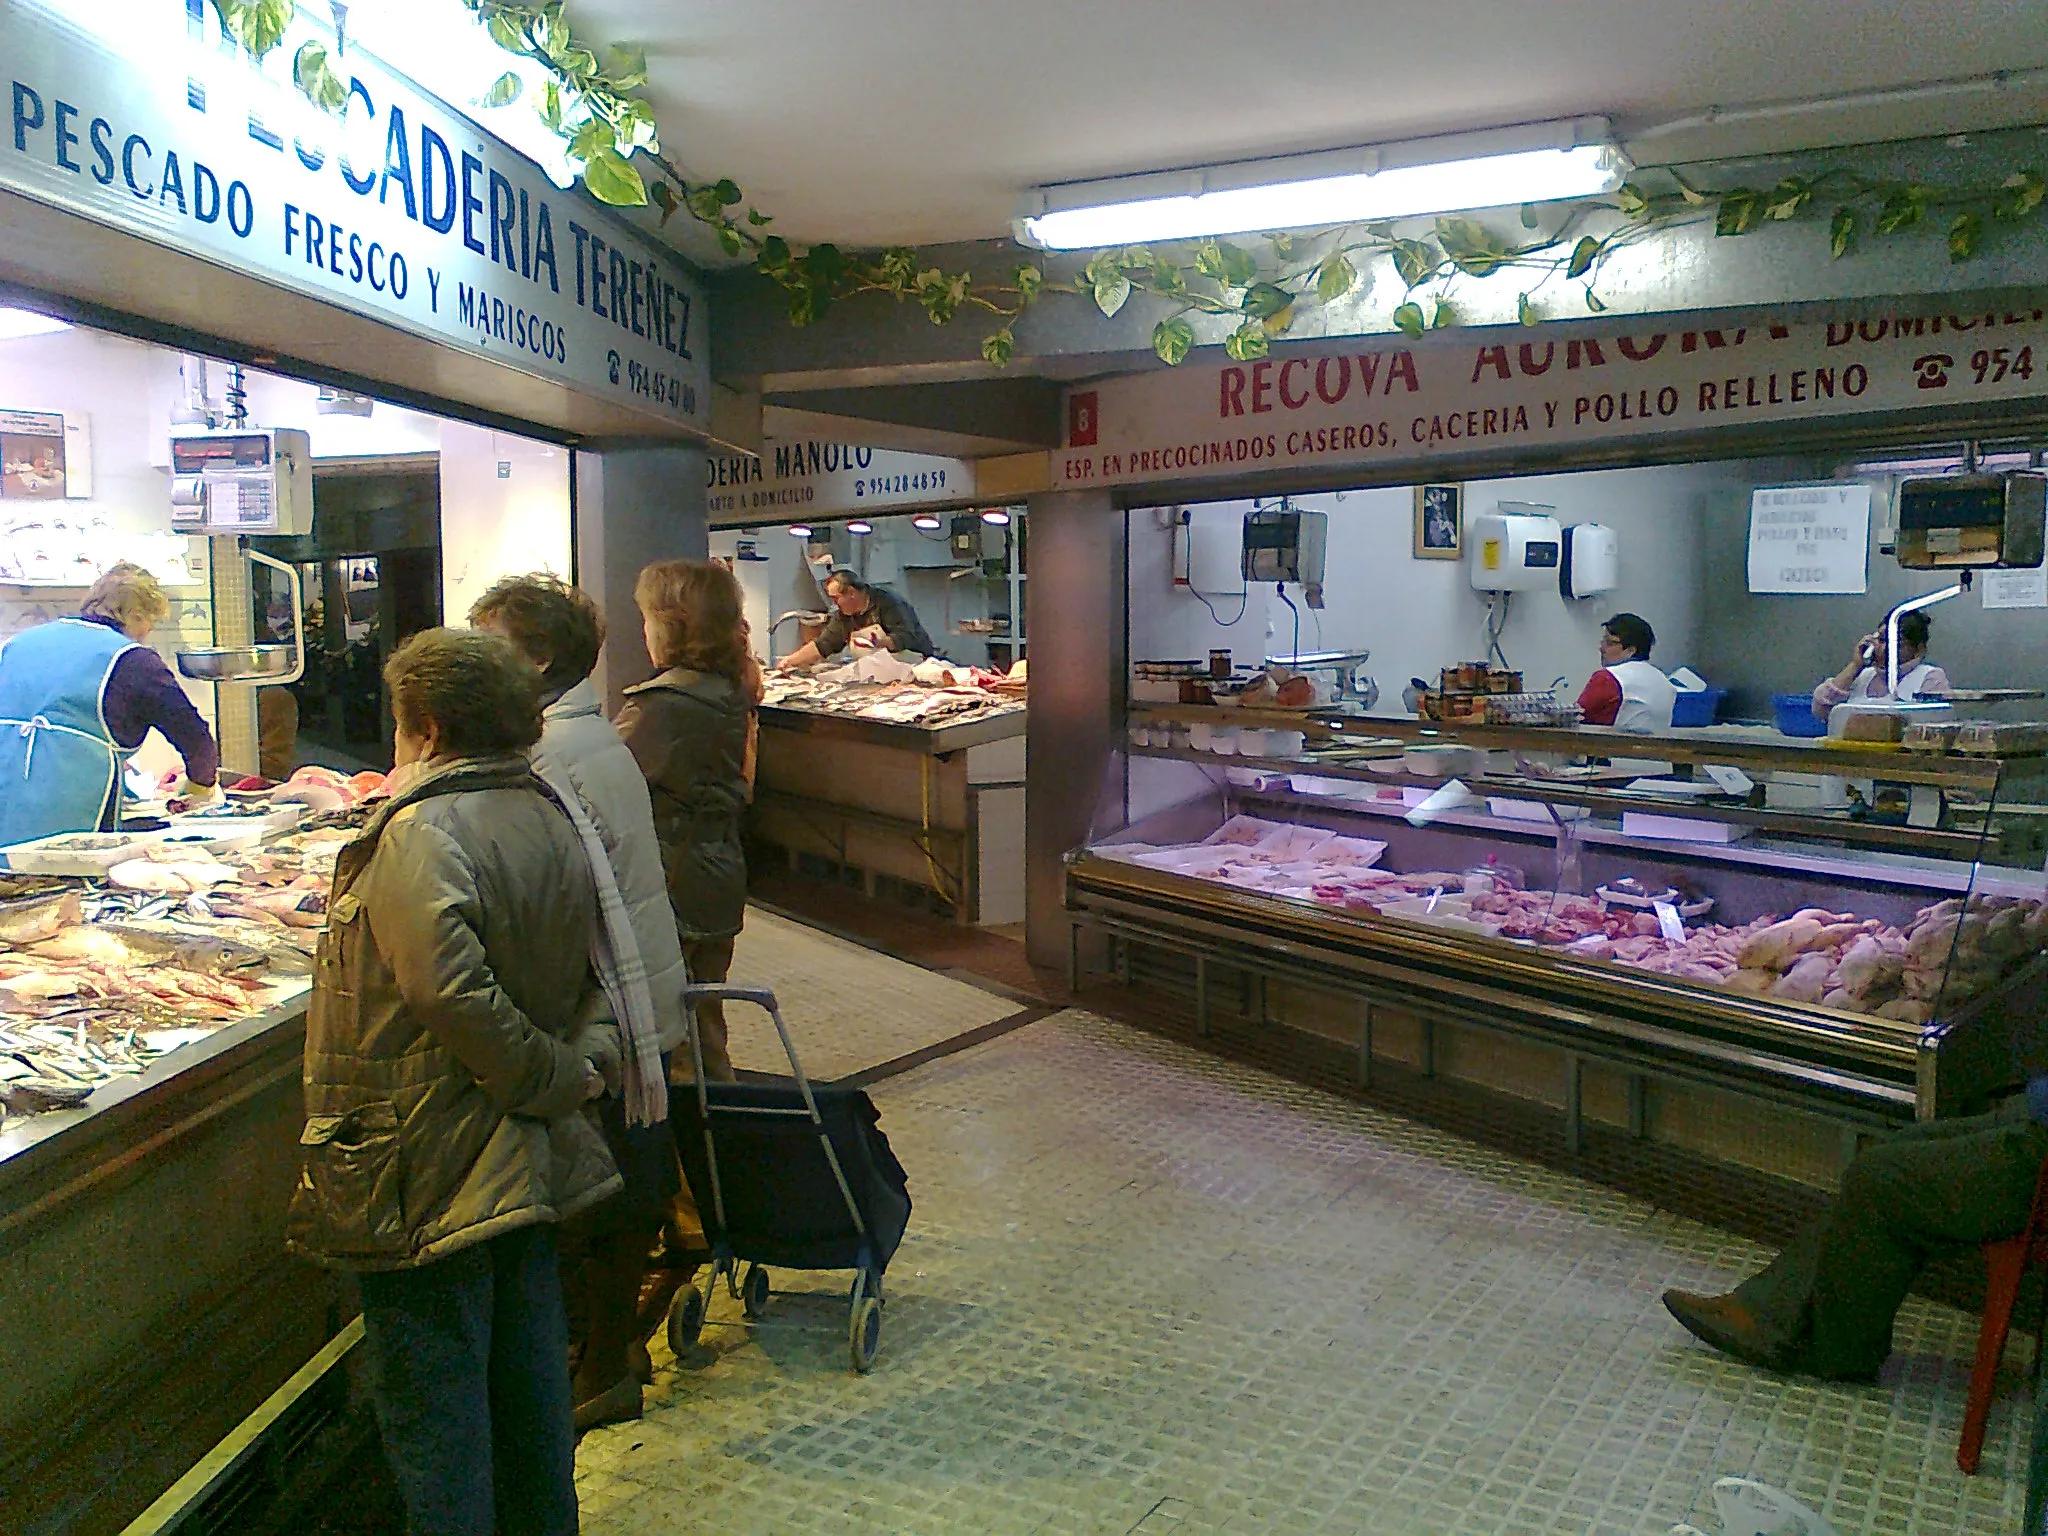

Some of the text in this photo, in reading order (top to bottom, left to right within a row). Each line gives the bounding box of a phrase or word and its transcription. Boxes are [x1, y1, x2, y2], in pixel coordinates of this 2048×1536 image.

[11, 80, 566, 365] PESCADO FRESCO Y MARISCOS
[568, 220, 692, 360] TEREÑEZ
[628, 360, 650, 397] 954
[1219, 350, 1419, 417] RECOVA
[1970, 344, 2034, 385] 954
[1065, 363, 1869, 480] ESP. EN PRECOCINADOS CASEROS, CACERIA Y POLLO RELLENO
[775, 441, 873, 479] MANOLO
